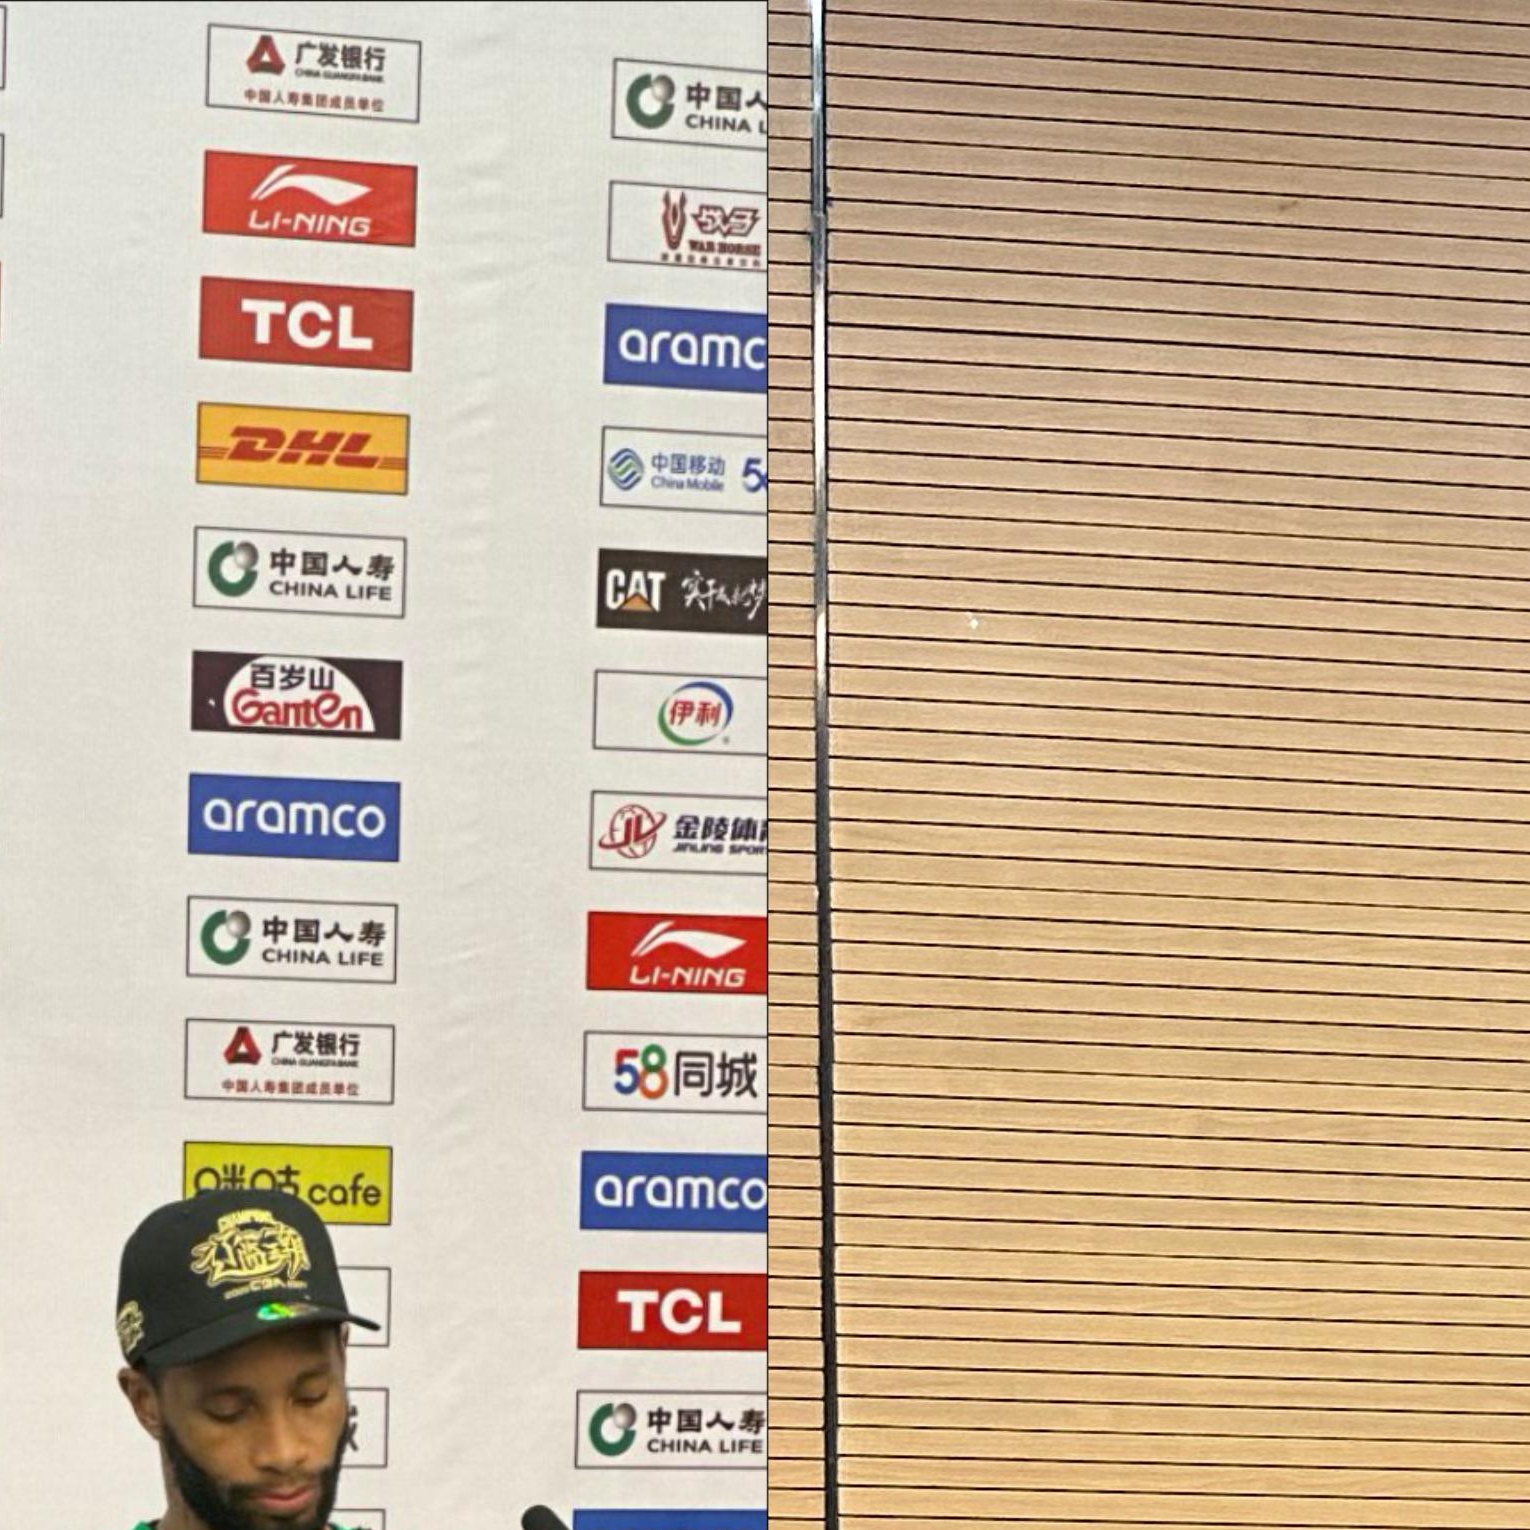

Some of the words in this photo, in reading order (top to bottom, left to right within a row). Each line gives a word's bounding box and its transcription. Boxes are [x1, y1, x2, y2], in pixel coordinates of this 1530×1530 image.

[296, 41, 386, 72] 广发银行
[686, 82, 767, 112] 中国人
[685, 113, 752, 133] CHINA
[248, 210, 371, 237] LI-NING
[241, 299, 373, 351] TCL
[620, 329, 767, 371] aramc
[227, 426, 378, 469] DHL
[651, 453, 725, 476] 中国移动
[651, 475, 685, 490] China
[686, 476, 724, 492] Mobile
[270, 548, 395, 581] 中国人寿
[270, 581, 338, 599] CHINA
[346, 585, 392, 601] LIFE
[606, 569, 666, 613] CAT
[250, 663, 335, 691] 百岁山
[669, 700, 722, 728] 伊利
[203, 798, 386, 838] aramco
[262, 916, 386, 947] 中国人寿
[262, 948, 331, 965] CHINA
[338, 951, 384, 966] LIFE
[630, 965, 747, 988] LI-NING
[271, 1031, 360, 1057] 广发银行
[614, 1044, 758, 1101] 58同城
[308, 1173, 381, 1206] cafe
[595, 1175, 767, 1210] aramco
[617, 1289, 742, 1334] TCL
[647, 1407, 766, 1436] 中国人寿
[647, 1439, 712, 1454] CHINA
[720, 1440, 764, 1455] LIFE
